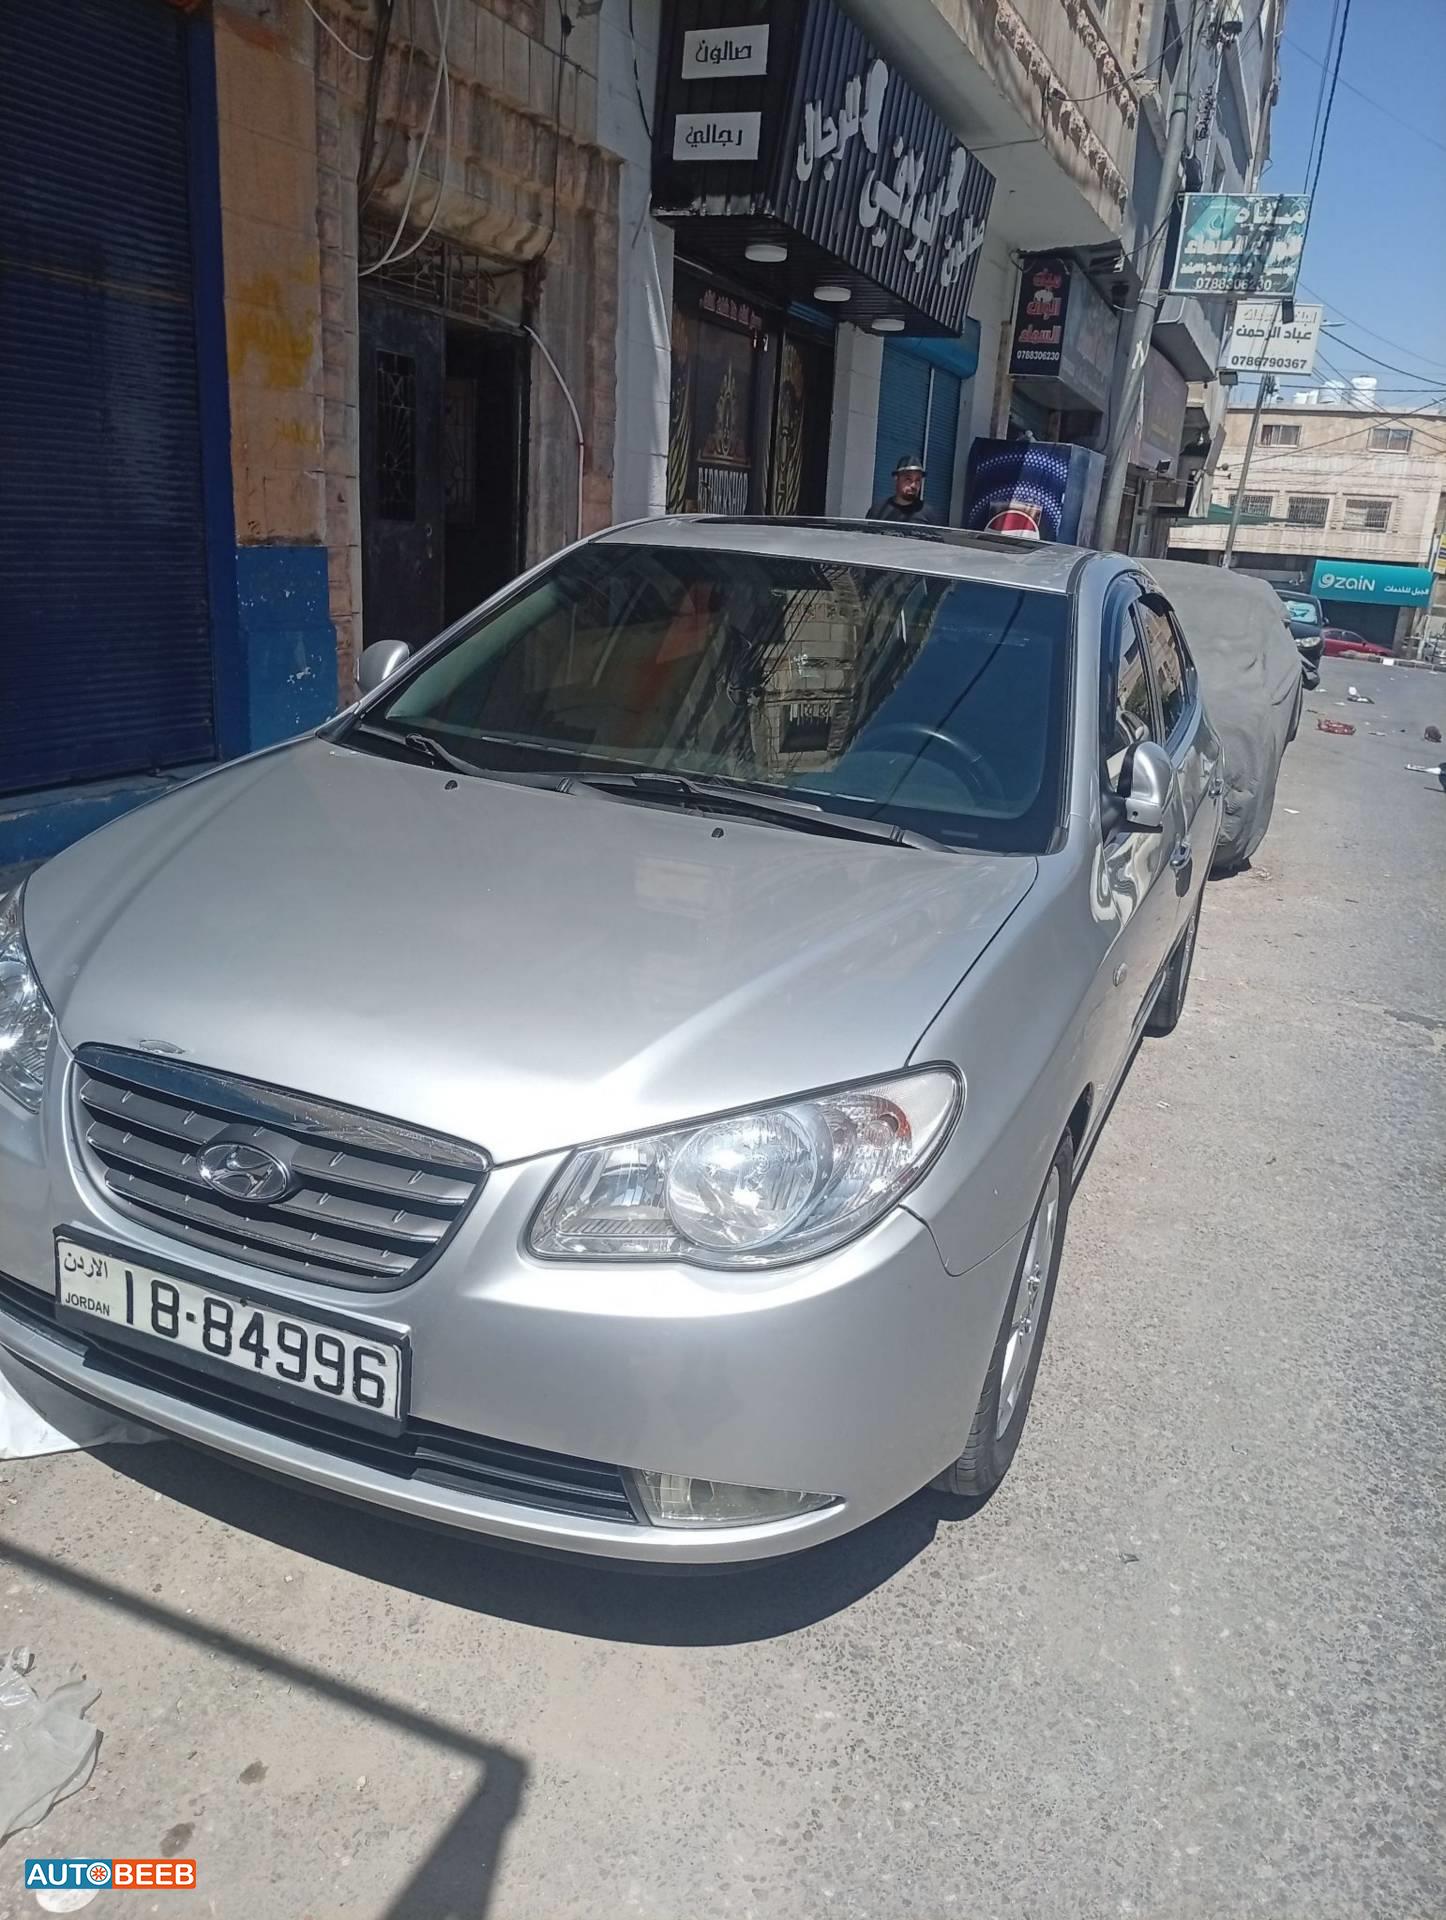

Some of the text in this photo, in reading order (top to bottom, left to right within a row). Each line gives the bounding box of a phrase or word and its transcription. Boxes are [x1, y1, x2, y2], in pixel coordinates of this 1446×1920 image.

[696, 39, 752, 64] صالون
[685, 123, 743, 148] رجالي
[939, 213, 985, 288] صالون
[1284, 327, 1312, 344] عباد
[1016, 350, 1060, 361] 0788306230
[1231, 355, 1308, 369] 0786790367
[65, 1292, 110, 1317] JORDAN
